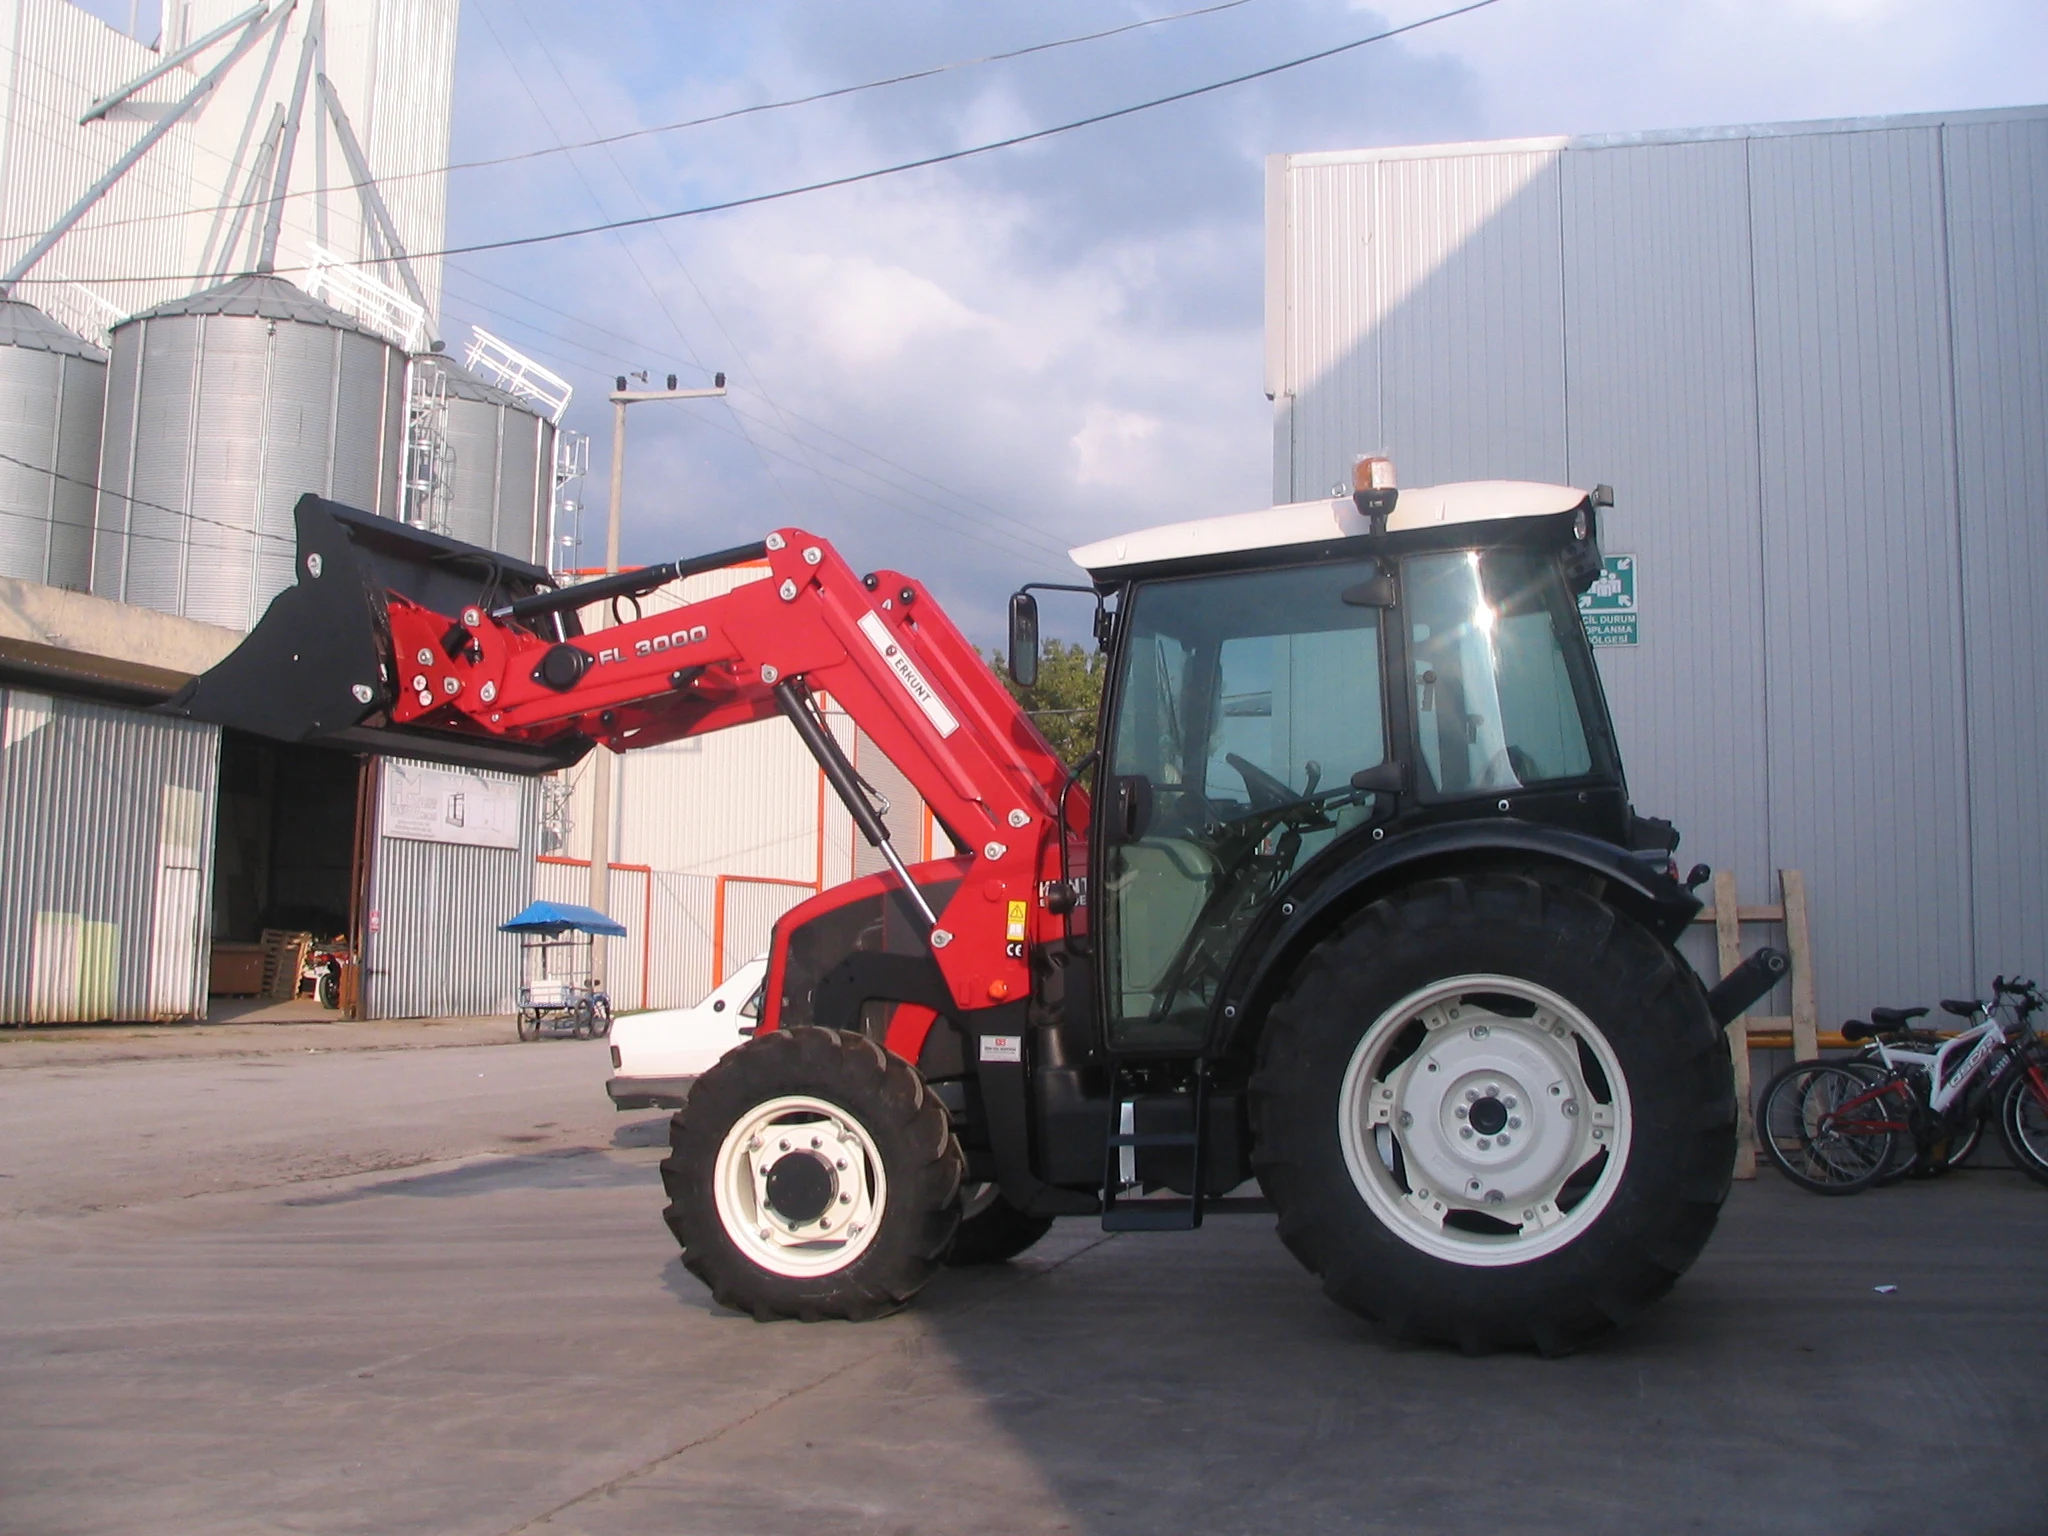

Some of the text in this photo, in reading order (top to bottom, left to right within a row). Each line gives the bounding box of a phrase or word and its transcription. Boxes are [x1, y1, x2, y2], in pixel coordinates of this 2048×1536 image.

[1582, 614, 1636, 625] CİL DURUM
[1585, 625, 1633, 635] OPLANMA
[1587, 634, 1628, 644] ÖLGESİ
[598, 625, 708, 667] FL 3000
[893, 658, 932, 704] ERKUNT
[1006, 943, 1022, 957] CE
